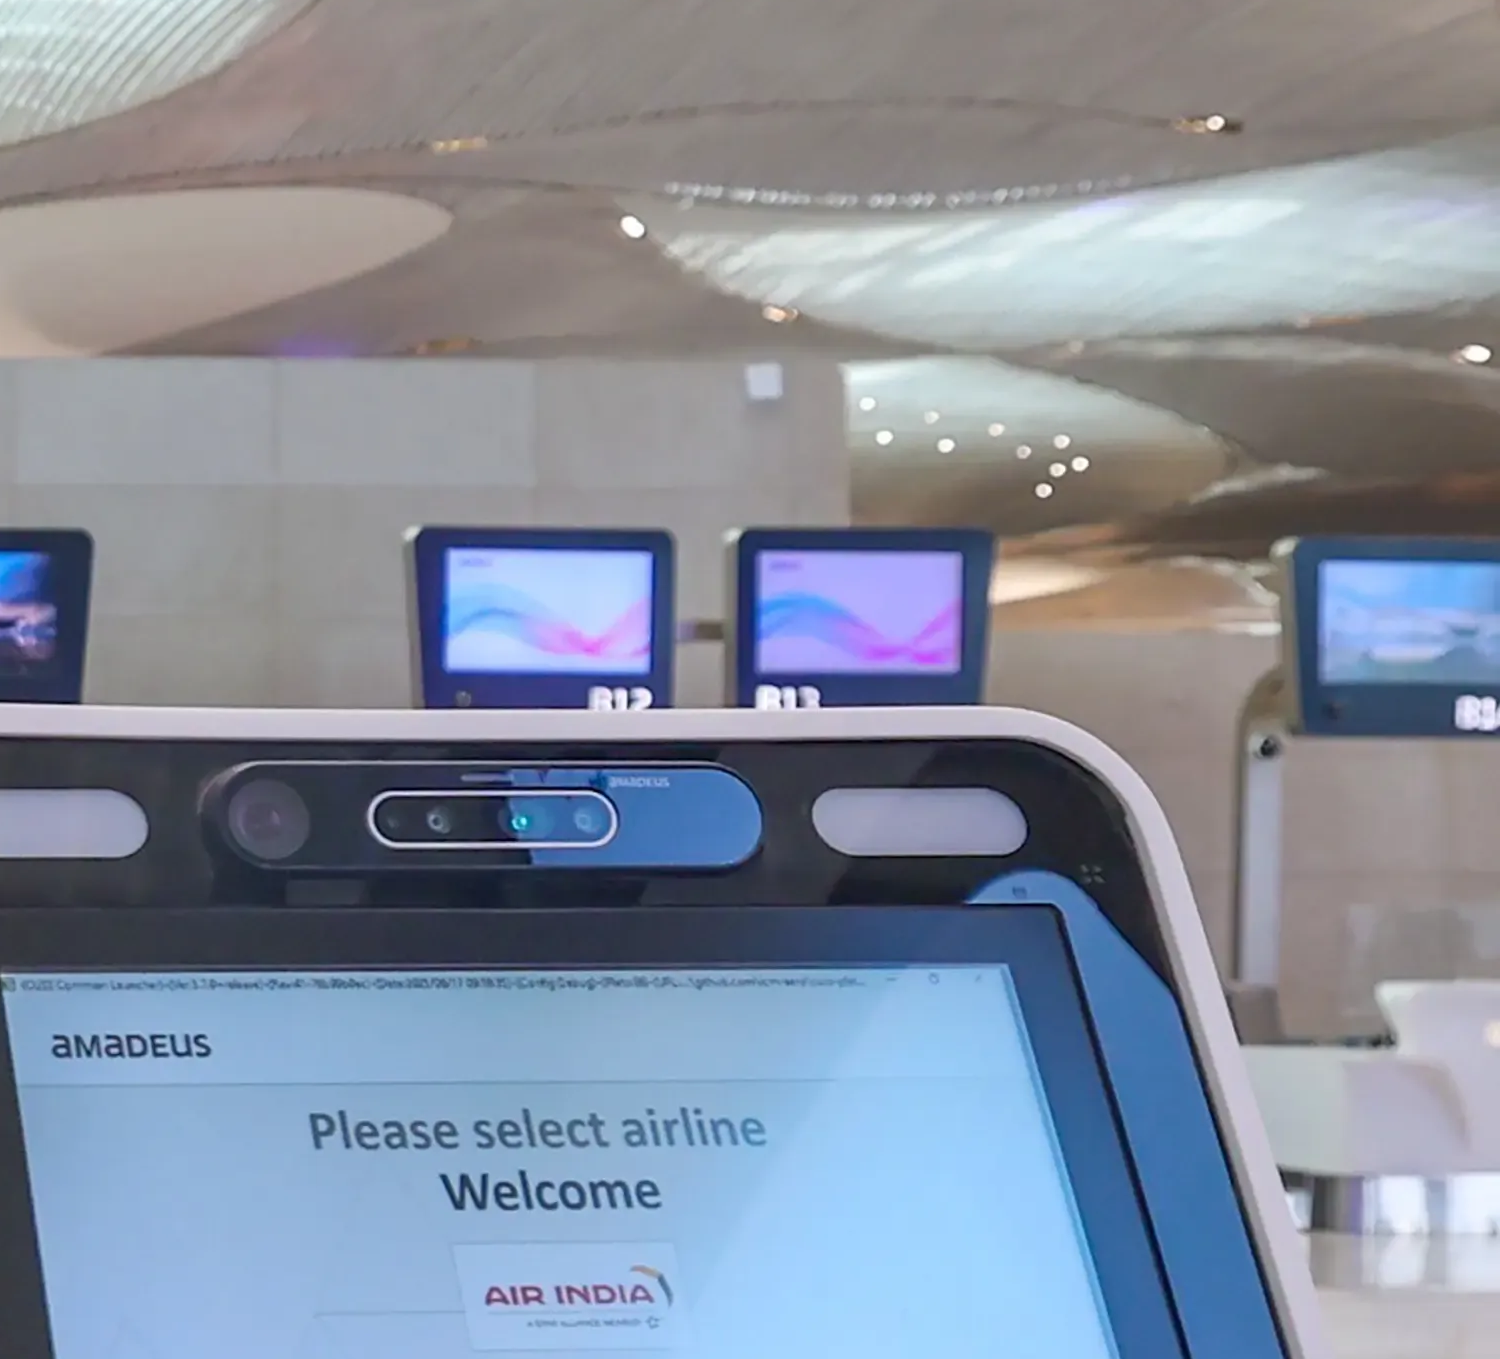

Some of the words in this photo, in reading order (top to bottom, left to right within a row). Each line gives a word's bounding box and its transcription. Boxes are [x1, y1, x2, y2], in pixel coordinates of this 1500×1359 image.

[1455, 694, 1500, 731] B1
[309, 1111, 460, 1152] Please
[474, 1110, 606, 1151] select
[620, 1108, 767, 1150] airline
[440, 1171, 663, 1213] Welcome
[484, 1285, 546, 1307] AIR
[554, 1284, 656, 1306] INDIA
